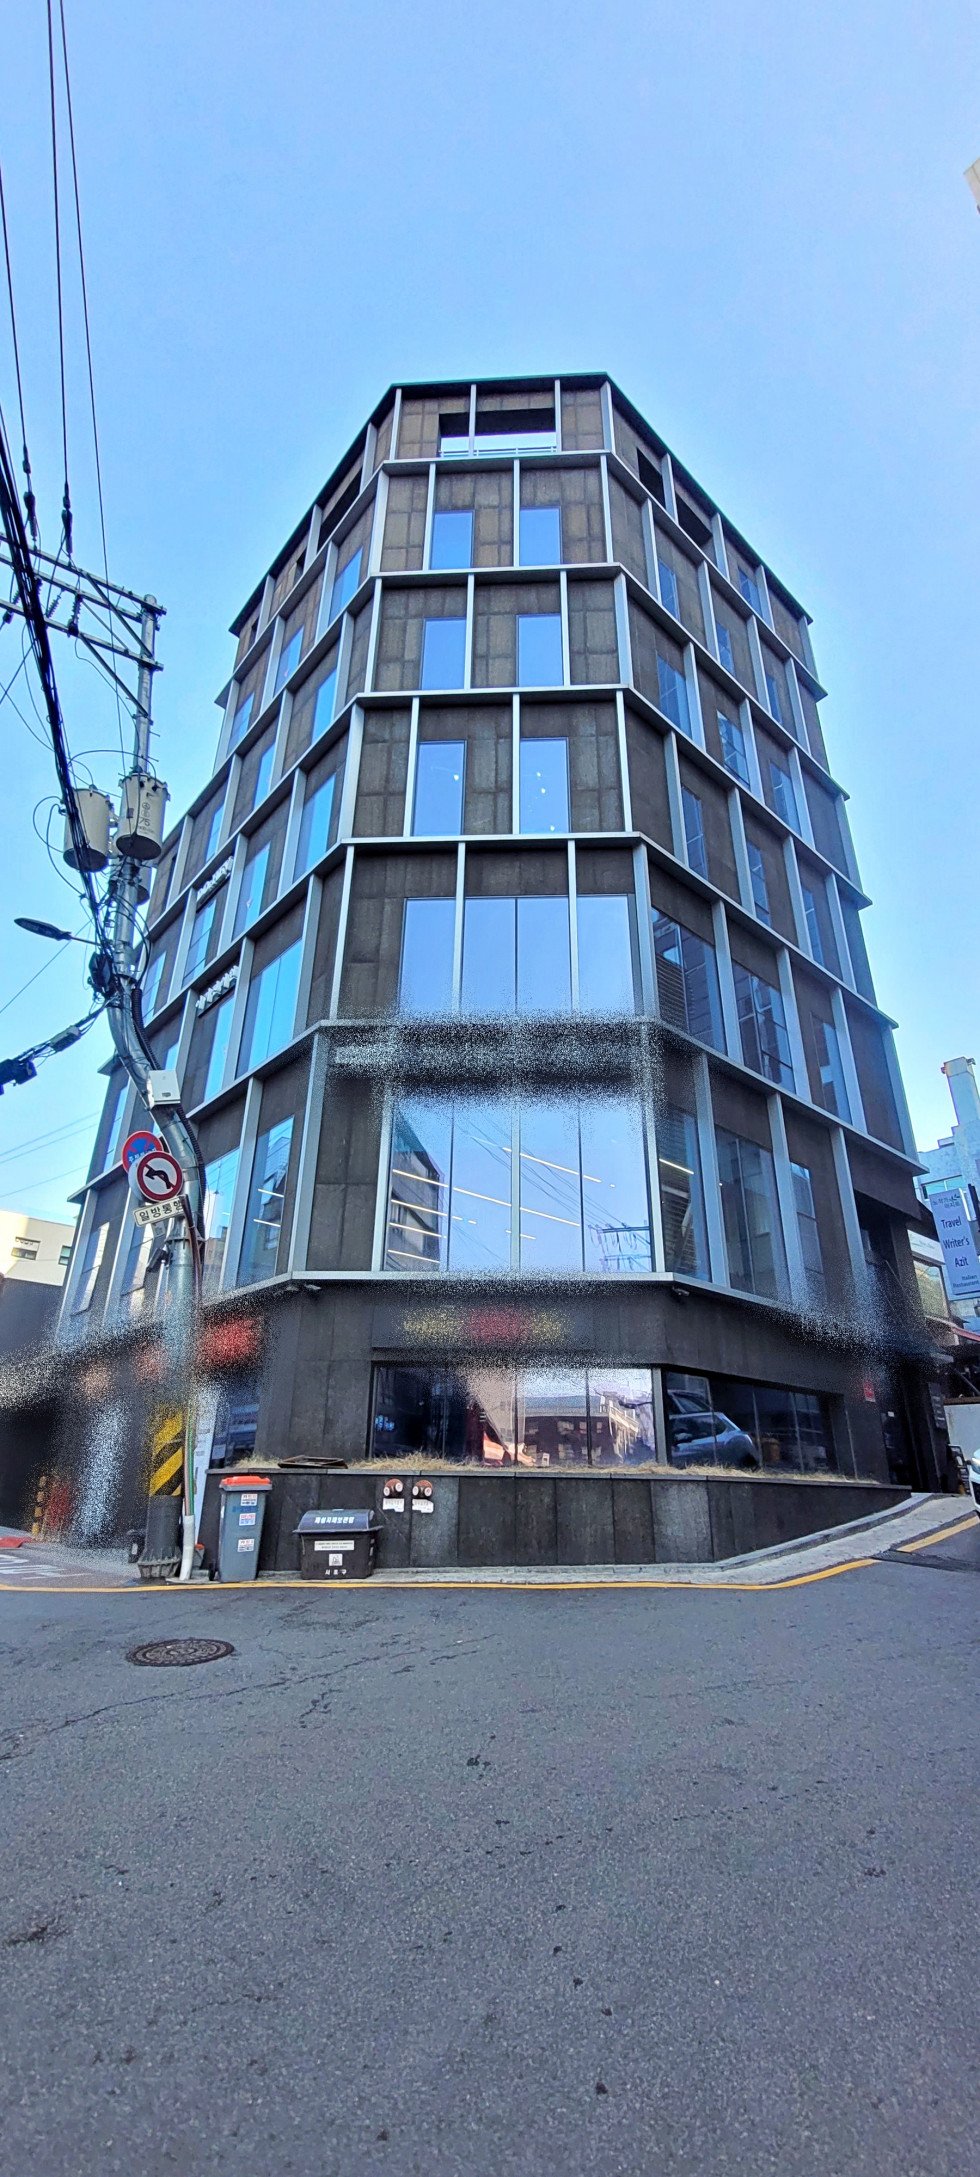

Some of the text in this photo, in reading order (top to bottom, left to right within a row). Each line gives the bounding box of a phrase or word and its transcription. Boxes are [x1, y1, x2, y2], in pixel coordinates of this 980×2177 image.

[139, 817, 151, 827] 75
[941, 1216, 962, 1229] Travel
[943, 1237, 970, 1249] Writer's
[954, 1256, 969, 1268] Azit
